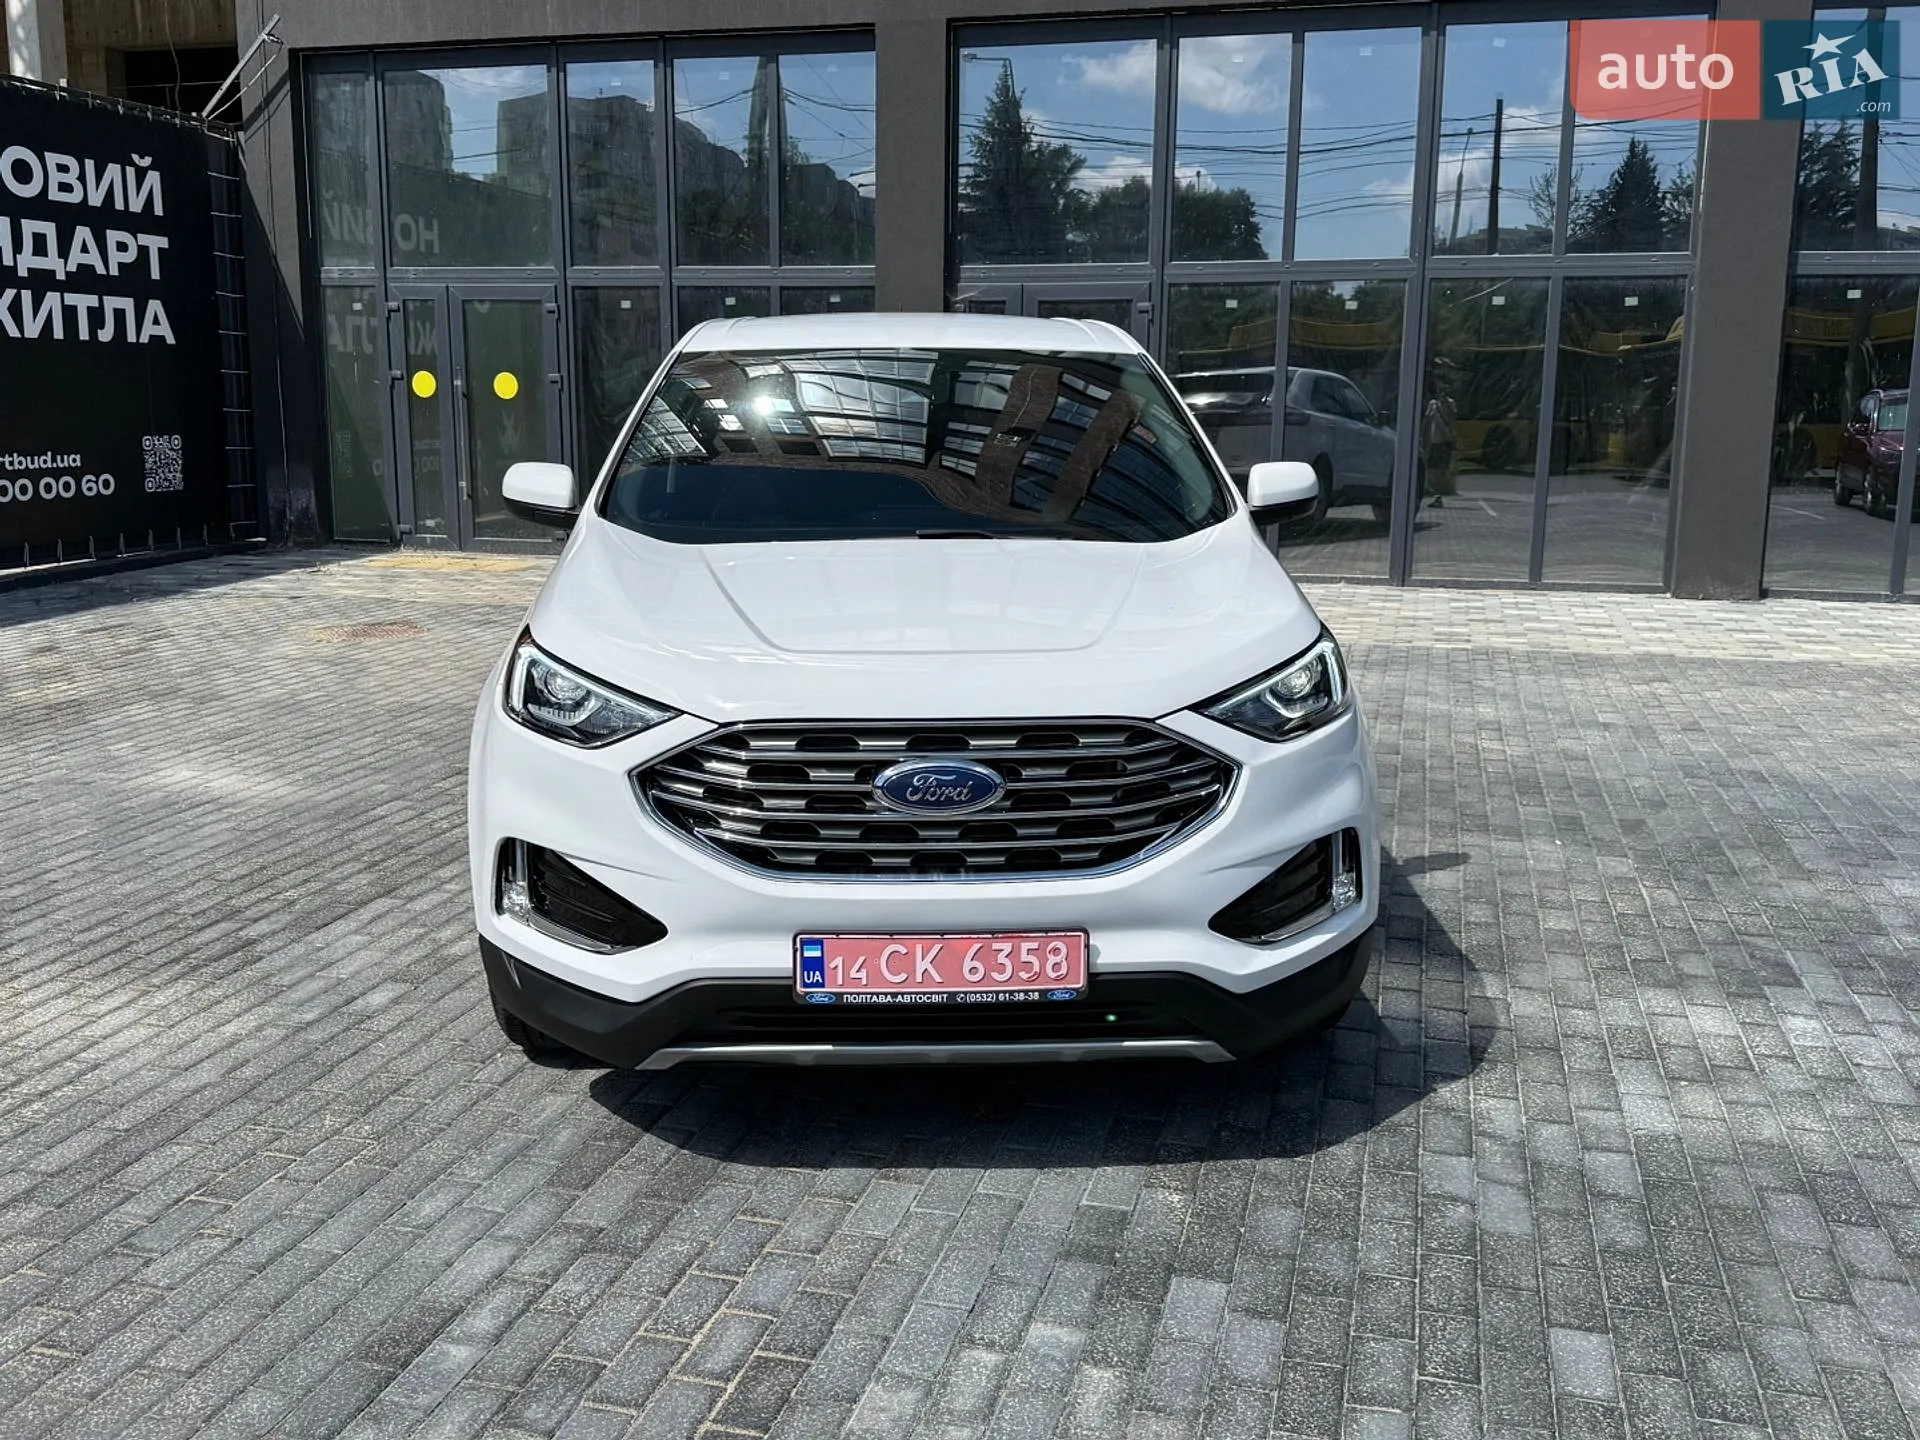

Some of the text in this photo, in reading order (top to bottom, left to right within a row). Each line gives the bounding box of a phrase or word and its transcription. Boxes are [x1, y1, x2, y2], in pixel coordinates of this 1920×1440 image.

[39, 476, 76, 500] 00
[81, 474, 115, 497] 60
[906, 773, 974, 801] Ford
[828, 956, 867, 986] 14
[962, 941, 1068, 983] 6358
[804, 972, 823, 984] UA
[966, 993, 996, 1003] (0532)
[998, 992, 1040, 1001] 61-38-38
